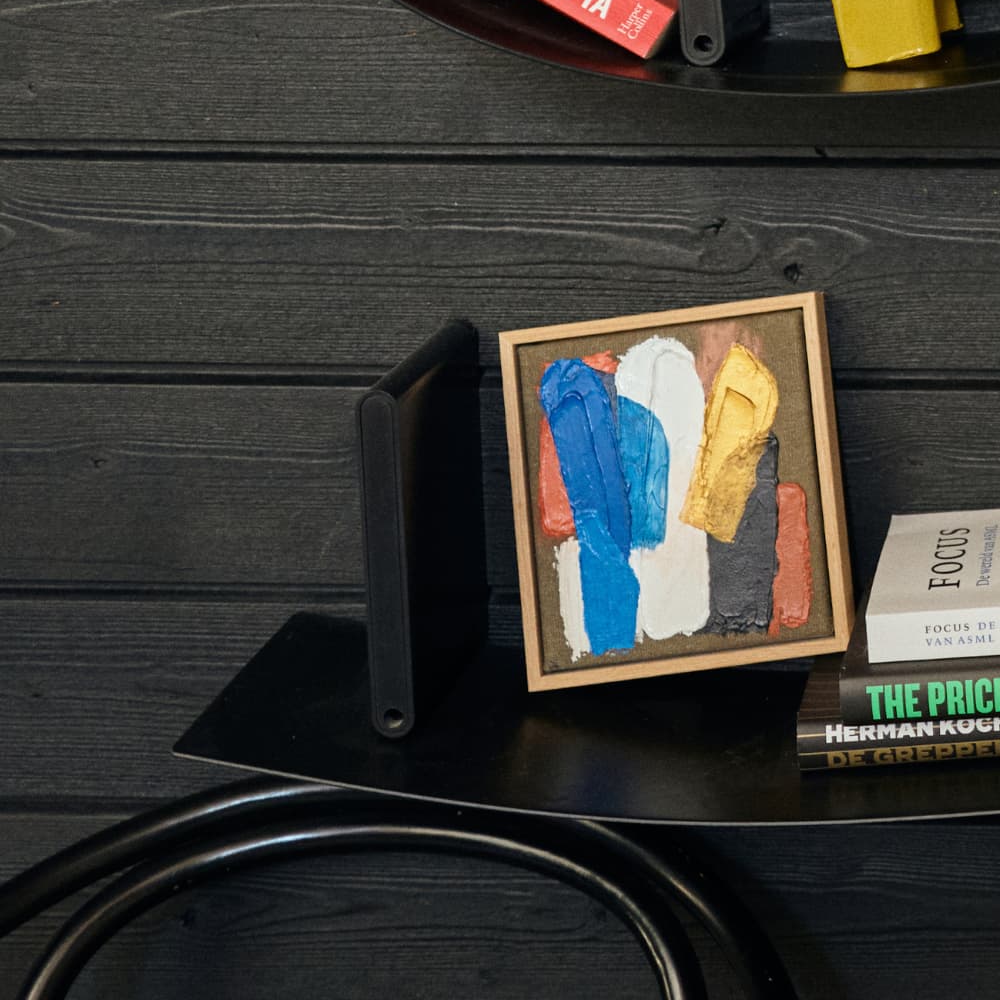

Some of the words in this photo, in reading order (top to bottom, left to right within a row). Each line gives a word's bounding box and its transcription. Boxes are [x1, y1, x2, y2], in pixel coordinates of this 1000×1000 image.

[616, 2, 644, 35] Harper
[627, 8, 653, 40] Collins
[928, 527, 970, 591] FOCUS
[924, 622, 970, 634] FOCUS
[977, 621, 996, 631] DE
[925, 636, 953, 647] VAN
[866, 682, 922, 720] THE
[825, 721, 934, 744] HERMAN
[826, 751, 864, 769] DE
